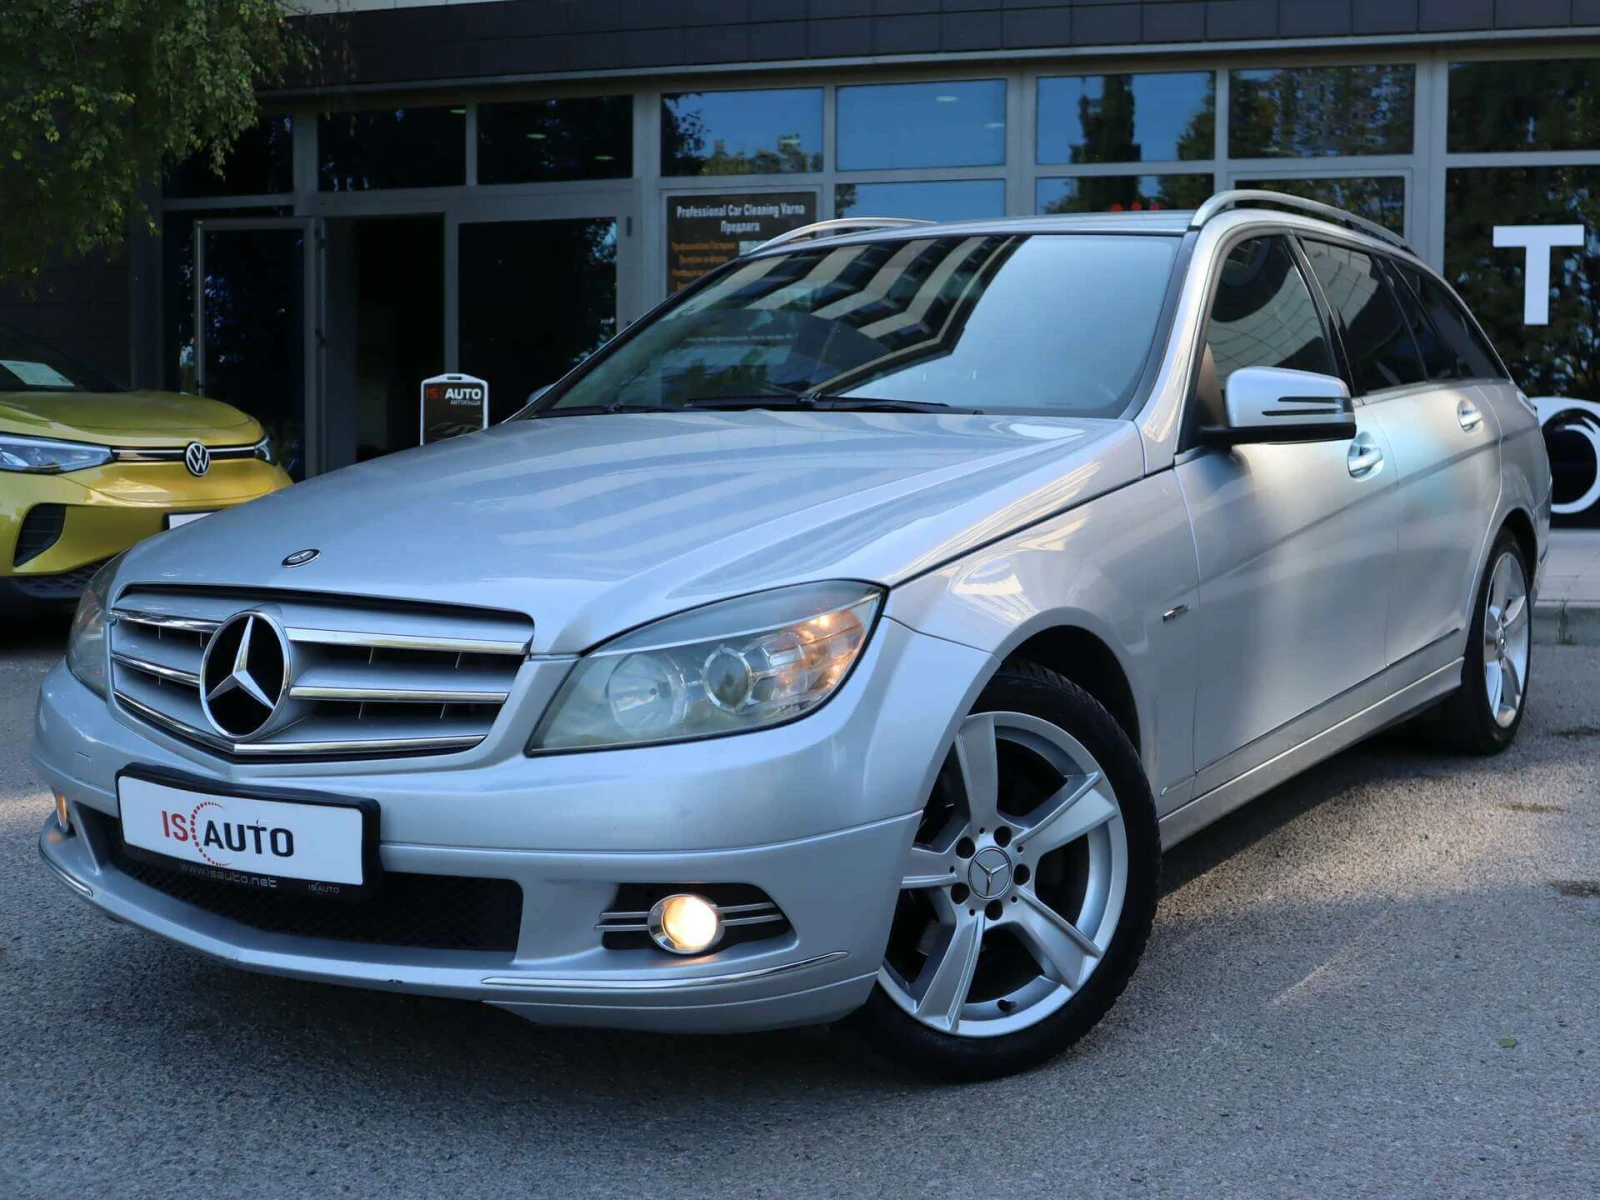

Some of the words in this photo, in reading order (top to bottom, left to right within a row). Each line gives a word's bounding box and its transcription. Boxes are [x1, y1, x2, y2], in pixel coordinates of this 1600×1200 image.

[676, 204, 726, 218] Professional
[728, 204, 742, 216] Car
[744, 203, 779, 218] Cleaning
[780, 202, 806, 216] Varna
[445, 388, 481, 399] AUTO
[161, 810, 189, 842] IS
[203, 820, 295, 858] AUTO
[180, 862, 277, 888] www.isauto.net
